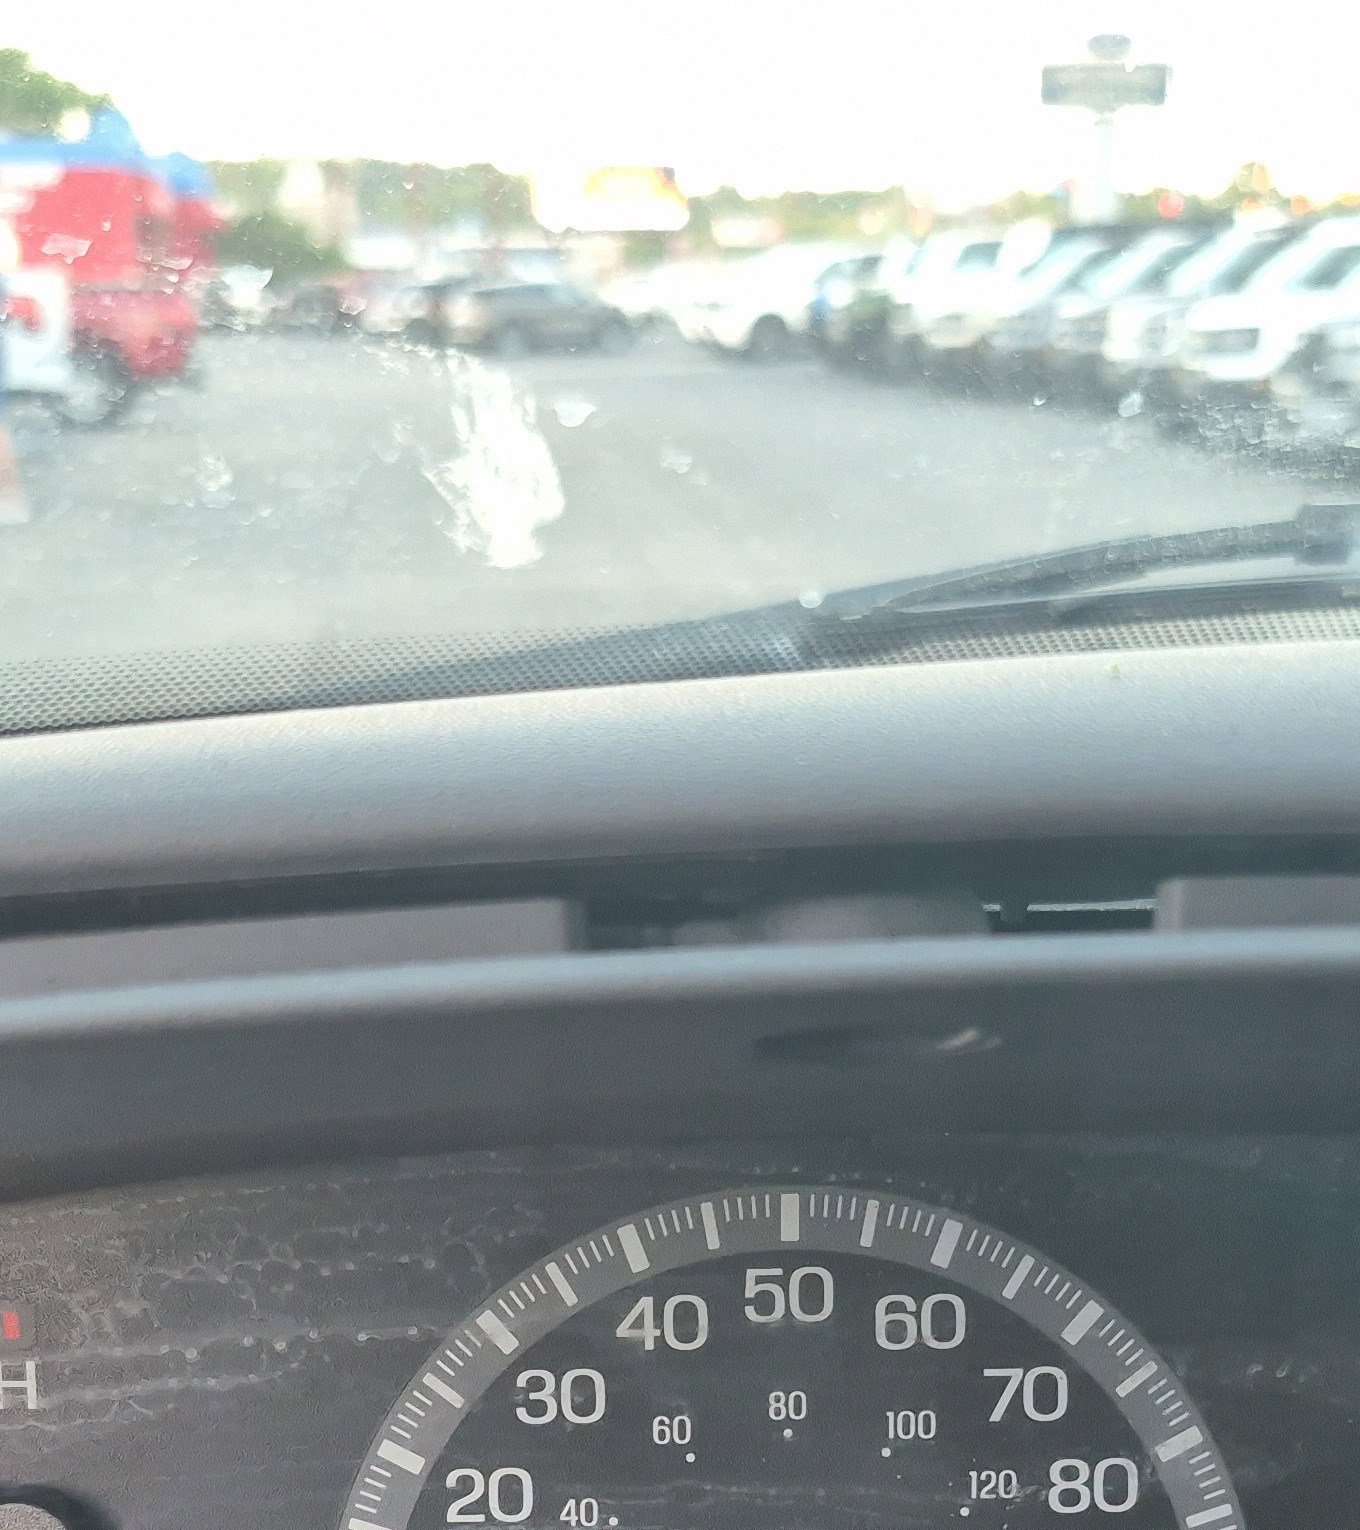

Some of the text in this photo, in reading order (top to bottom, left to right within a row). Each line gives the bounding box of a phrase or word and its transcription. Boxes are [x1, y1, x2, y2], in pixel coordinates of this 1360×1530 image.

[615, 1295, 709, 1351] 40
[744, 1266, 835, 1324] 50
[874, 1293, 967, 1350] 60
[515, 1368, 607, 1425] 30
[768, 1391, 808, 1421] 80
[982, 1366, 1069, 1423] 70
[652, 1416, 692, 1445] 60
[886, 1410, 937, 1440] 100
[445, 1467, 535, 1523] 20
[559, 1498, 599, 1527] 40
[968, 1470, 1018, 1500] 120
[1047, 1457, 1139, 1514] 80
